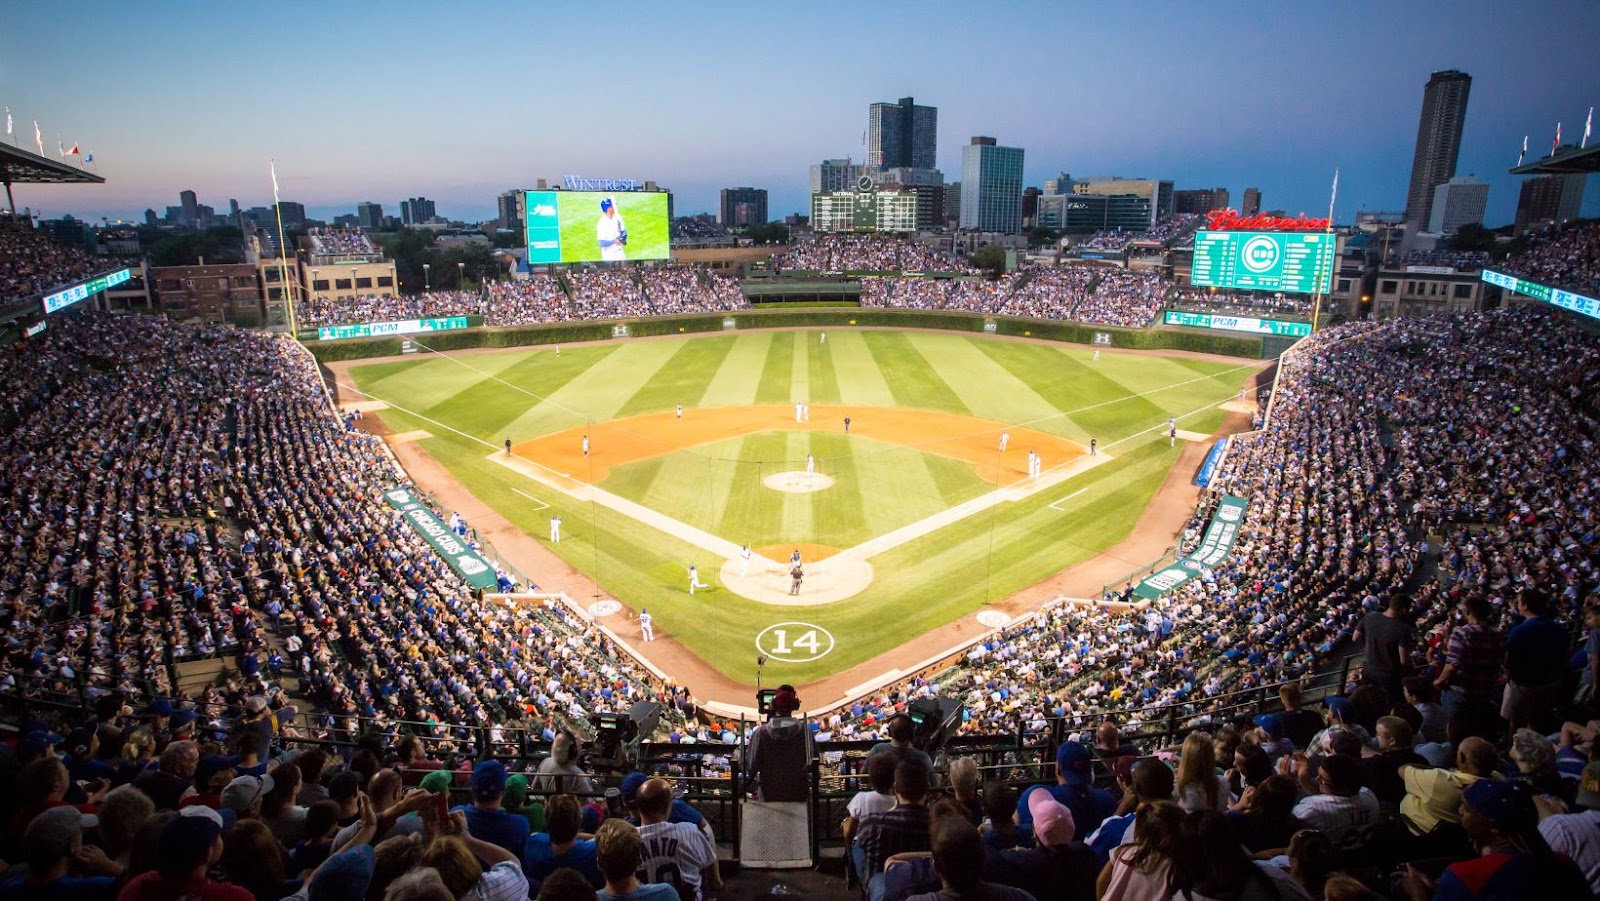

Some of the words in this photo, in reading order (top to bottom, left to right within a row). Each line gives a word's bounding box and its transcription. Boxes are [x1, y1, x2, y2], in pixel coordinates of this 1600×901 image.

[563, 175, 637, 191] WINTRUST
[409, 509, 446, 537] CHICAGO
[435, 534, 465, 556] CUBS
[771, 629, 820, 654] 14
[640, 837, 678, 862] ANTO
